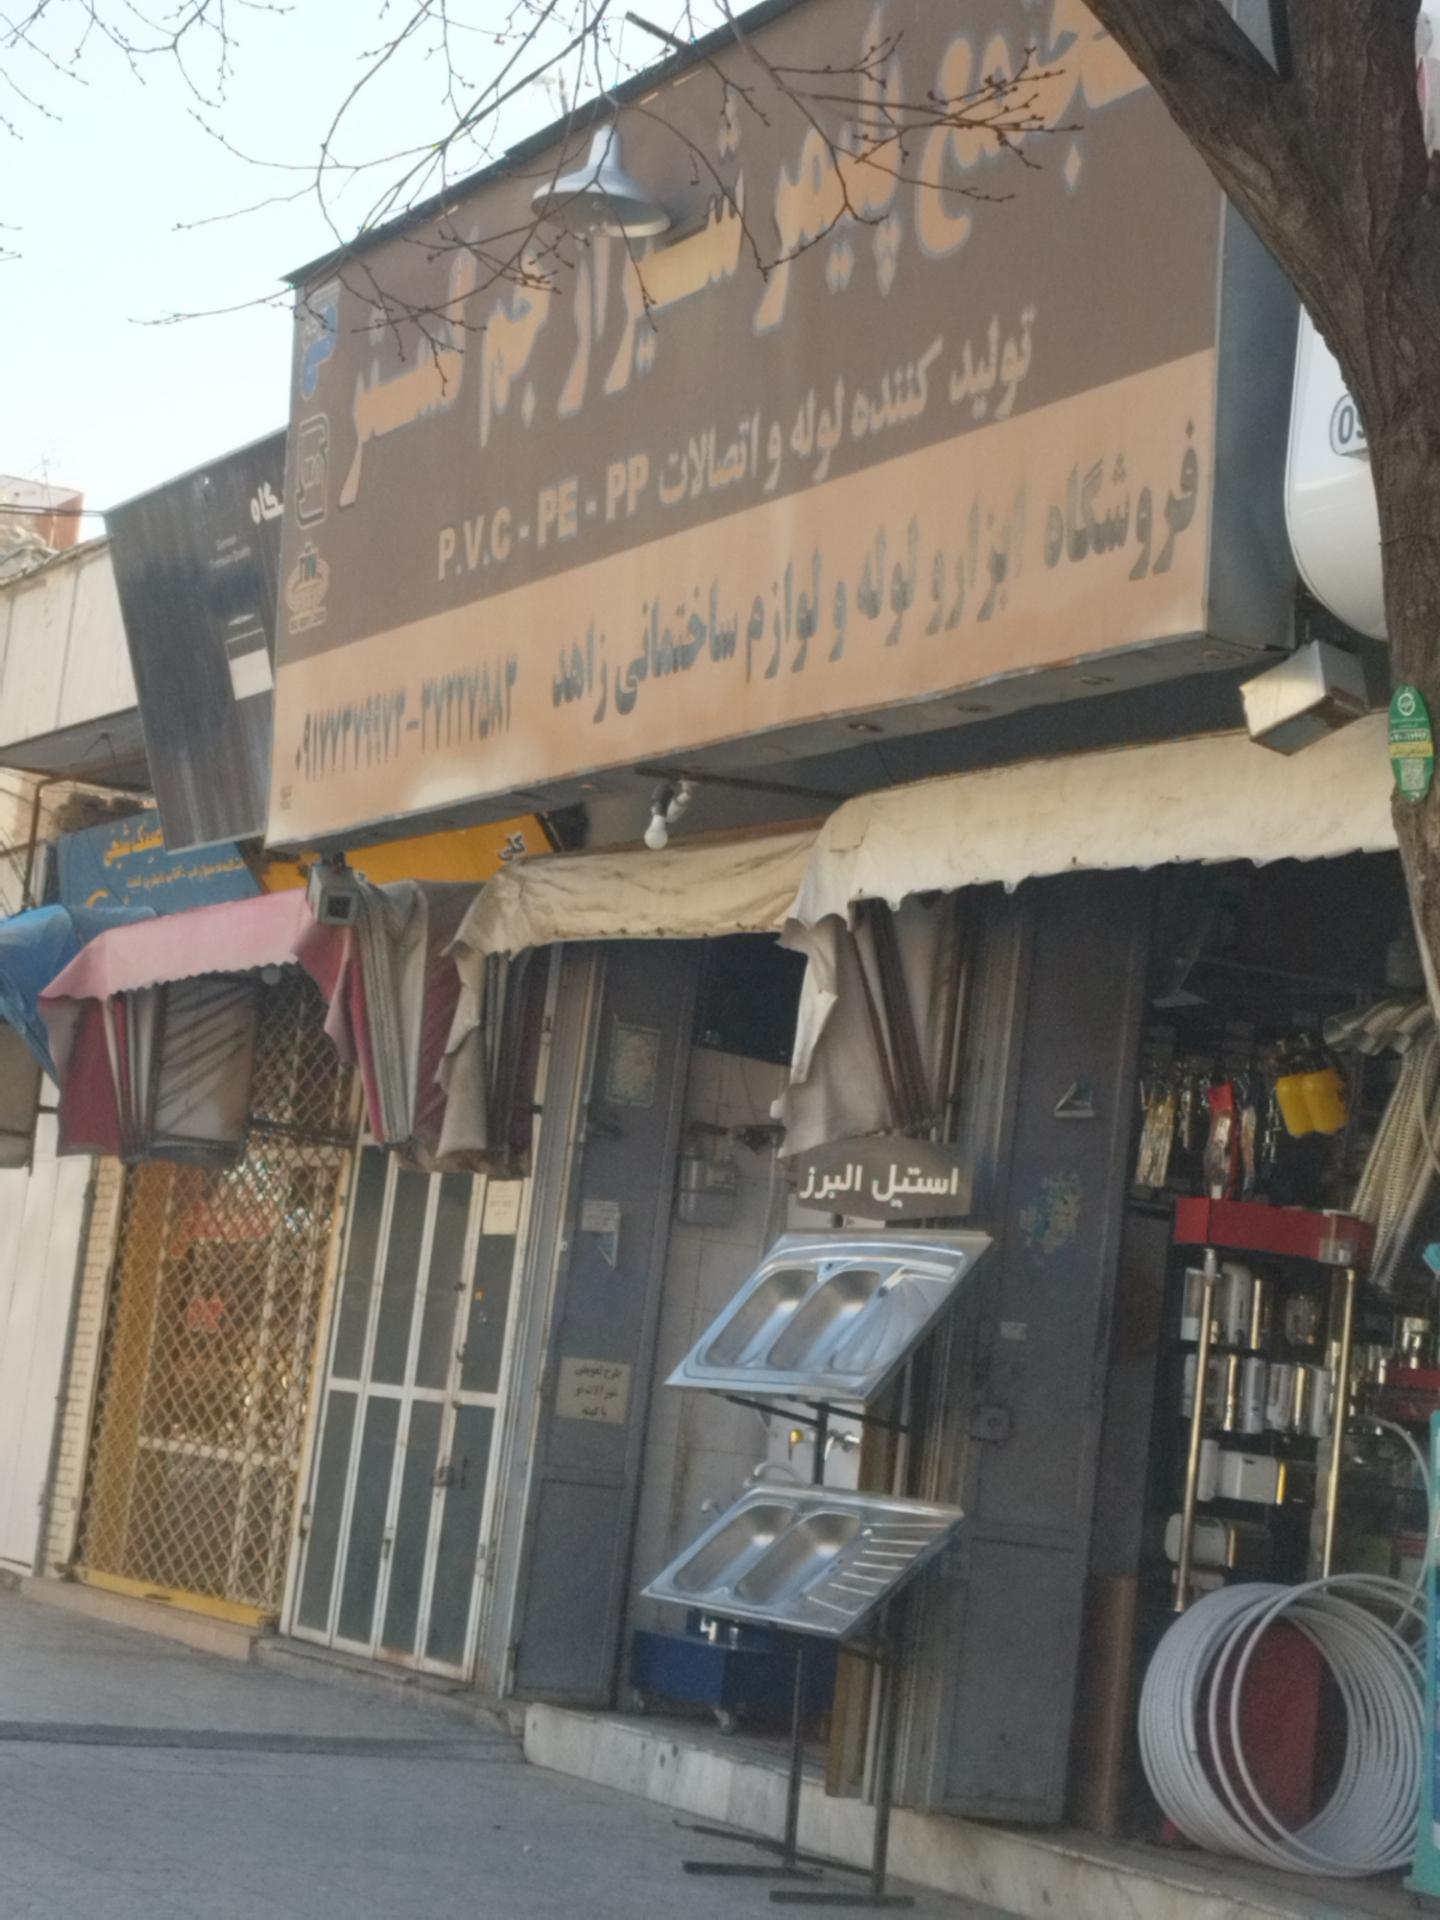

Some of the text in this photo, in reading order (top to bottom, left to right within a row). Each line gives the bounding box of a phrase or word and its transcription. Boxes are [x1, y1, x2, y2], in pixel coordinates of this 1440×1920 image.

[753, 5, 902, 335] پلیمر
[917, 0, 1151, 258] جتمع
[339, 226, 480, 508] گستر
[850, 334, 943, 439] کننده
[949, 303, 1037, 421] تولید
[659, 410, 761, 504] اتصالات
[763, 420, 784, 492] و
[790, 376, 845, 482] لوله
[537, 479, 579, 547] PE
[605, 453, 649, 521] PP
[1043, 417, 1199, 581] فروشگاه
[858, 514, 920, 648] لوله
[925, 547, 946, 636] و
[944, 478, 1026, 632] ابزار
[614, 577, 738, 716] ساختمانی
[745, 546, 823, 684] لوازم
[829, 579, 848, 663] و
[798, 1162, 959, 1208] استیل البرز
